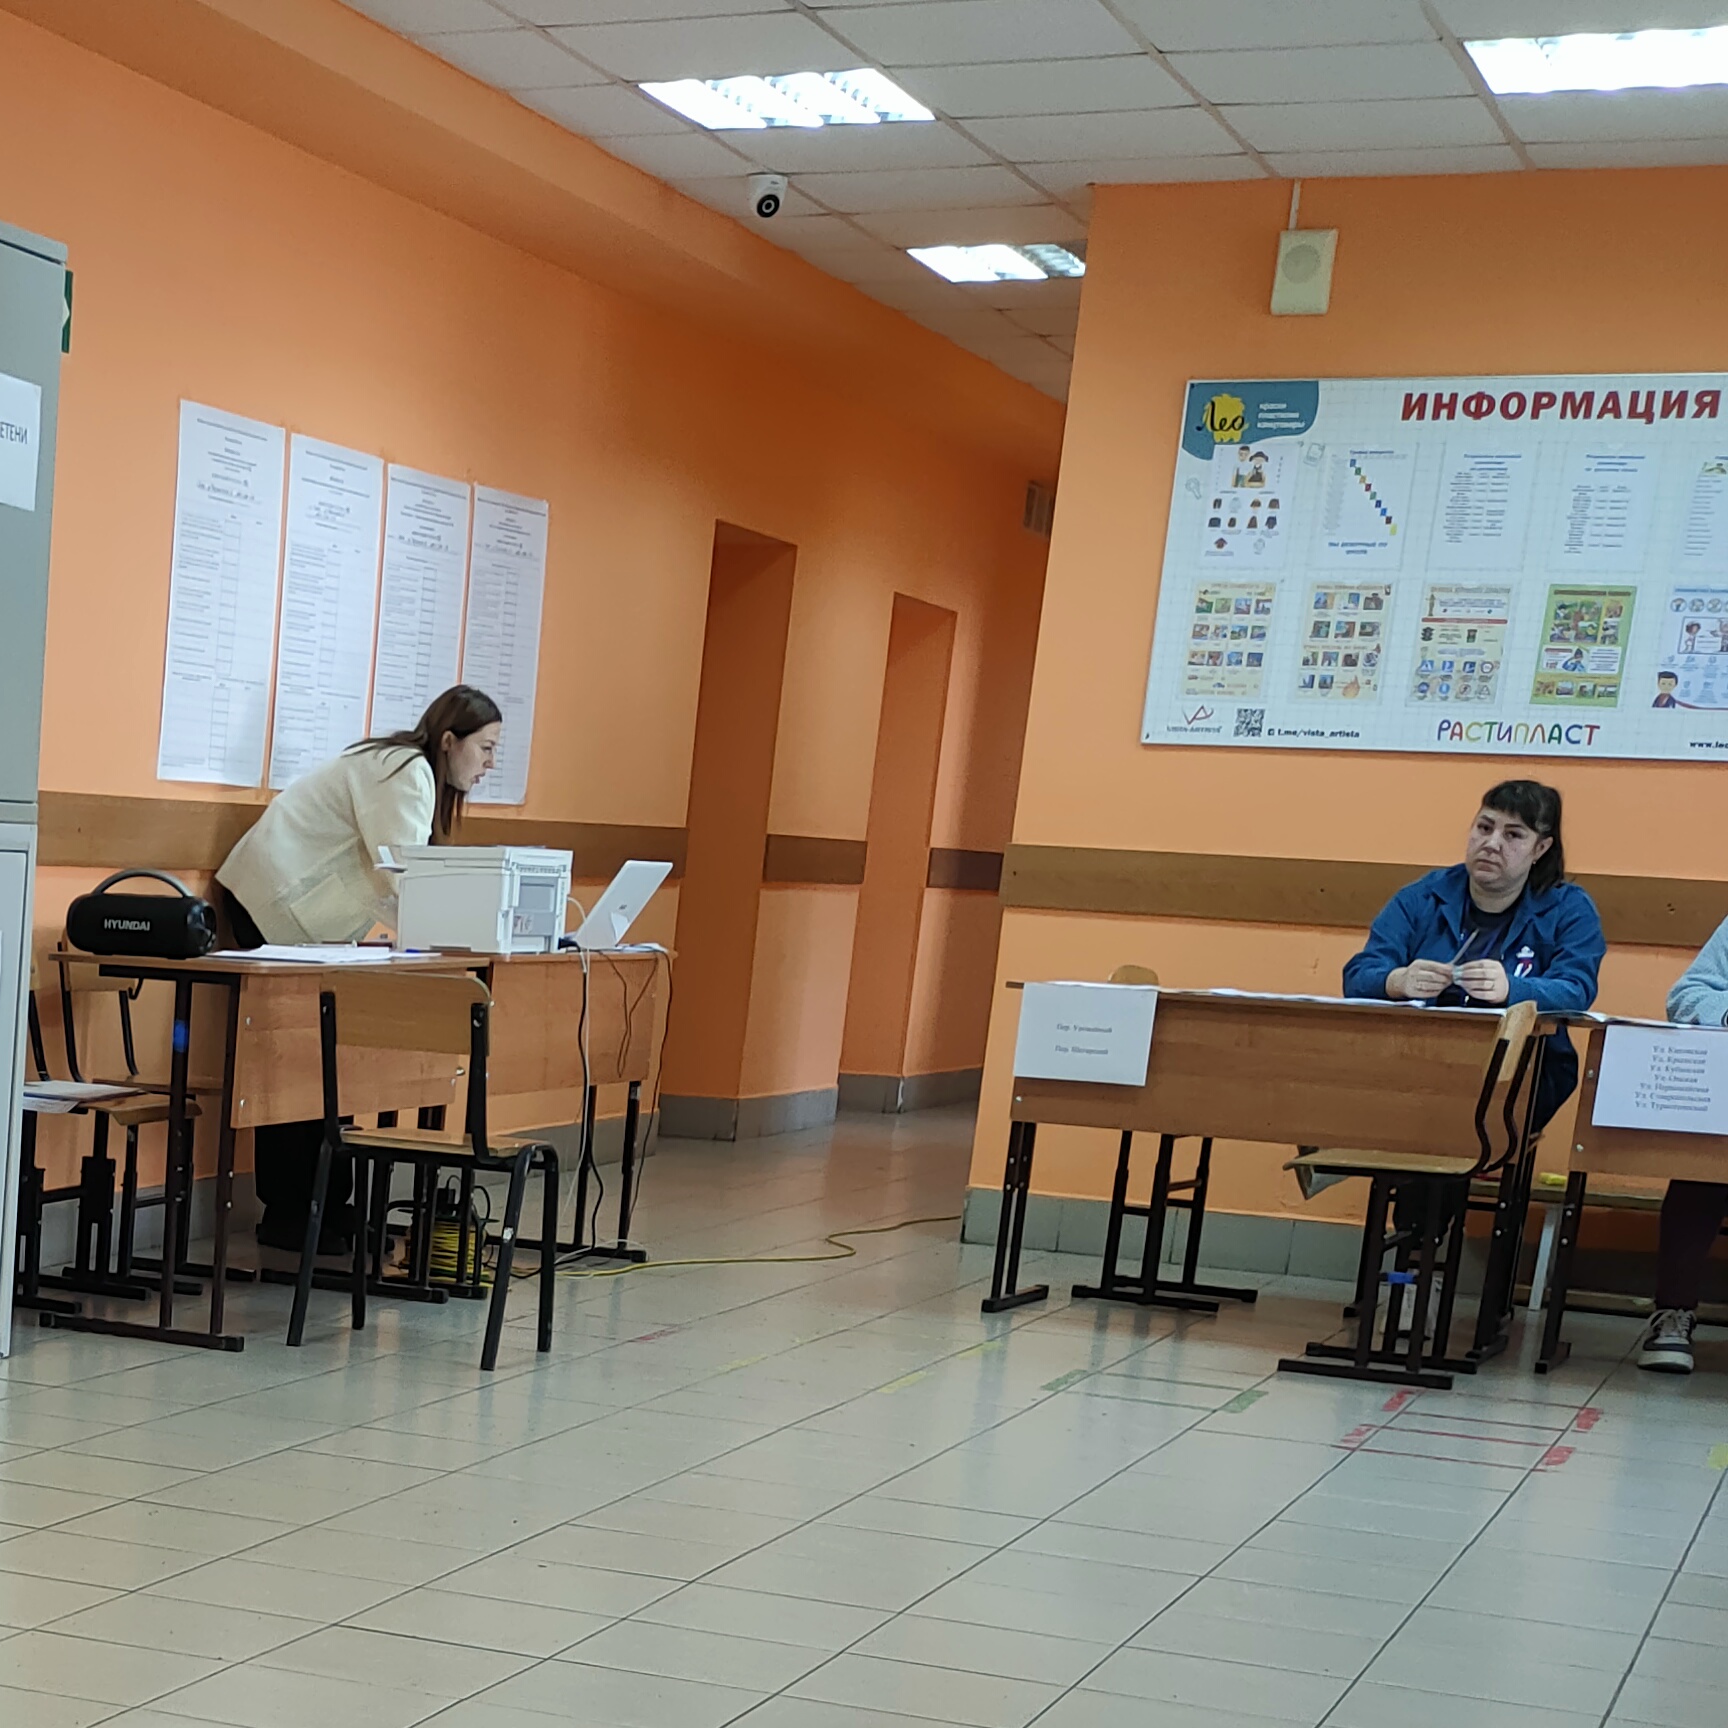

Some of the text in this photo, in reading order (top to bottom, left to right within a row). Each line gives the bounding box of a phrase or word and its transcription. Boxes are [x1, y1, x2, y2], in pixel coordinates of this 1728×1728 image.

[1401, 390, 1721, 425] ИНФОРМАЦИЯ
[1437, 719, 1600, 746] РАСТИПЛАСТ
[104, 918, 150, 931] HYUNDAI
